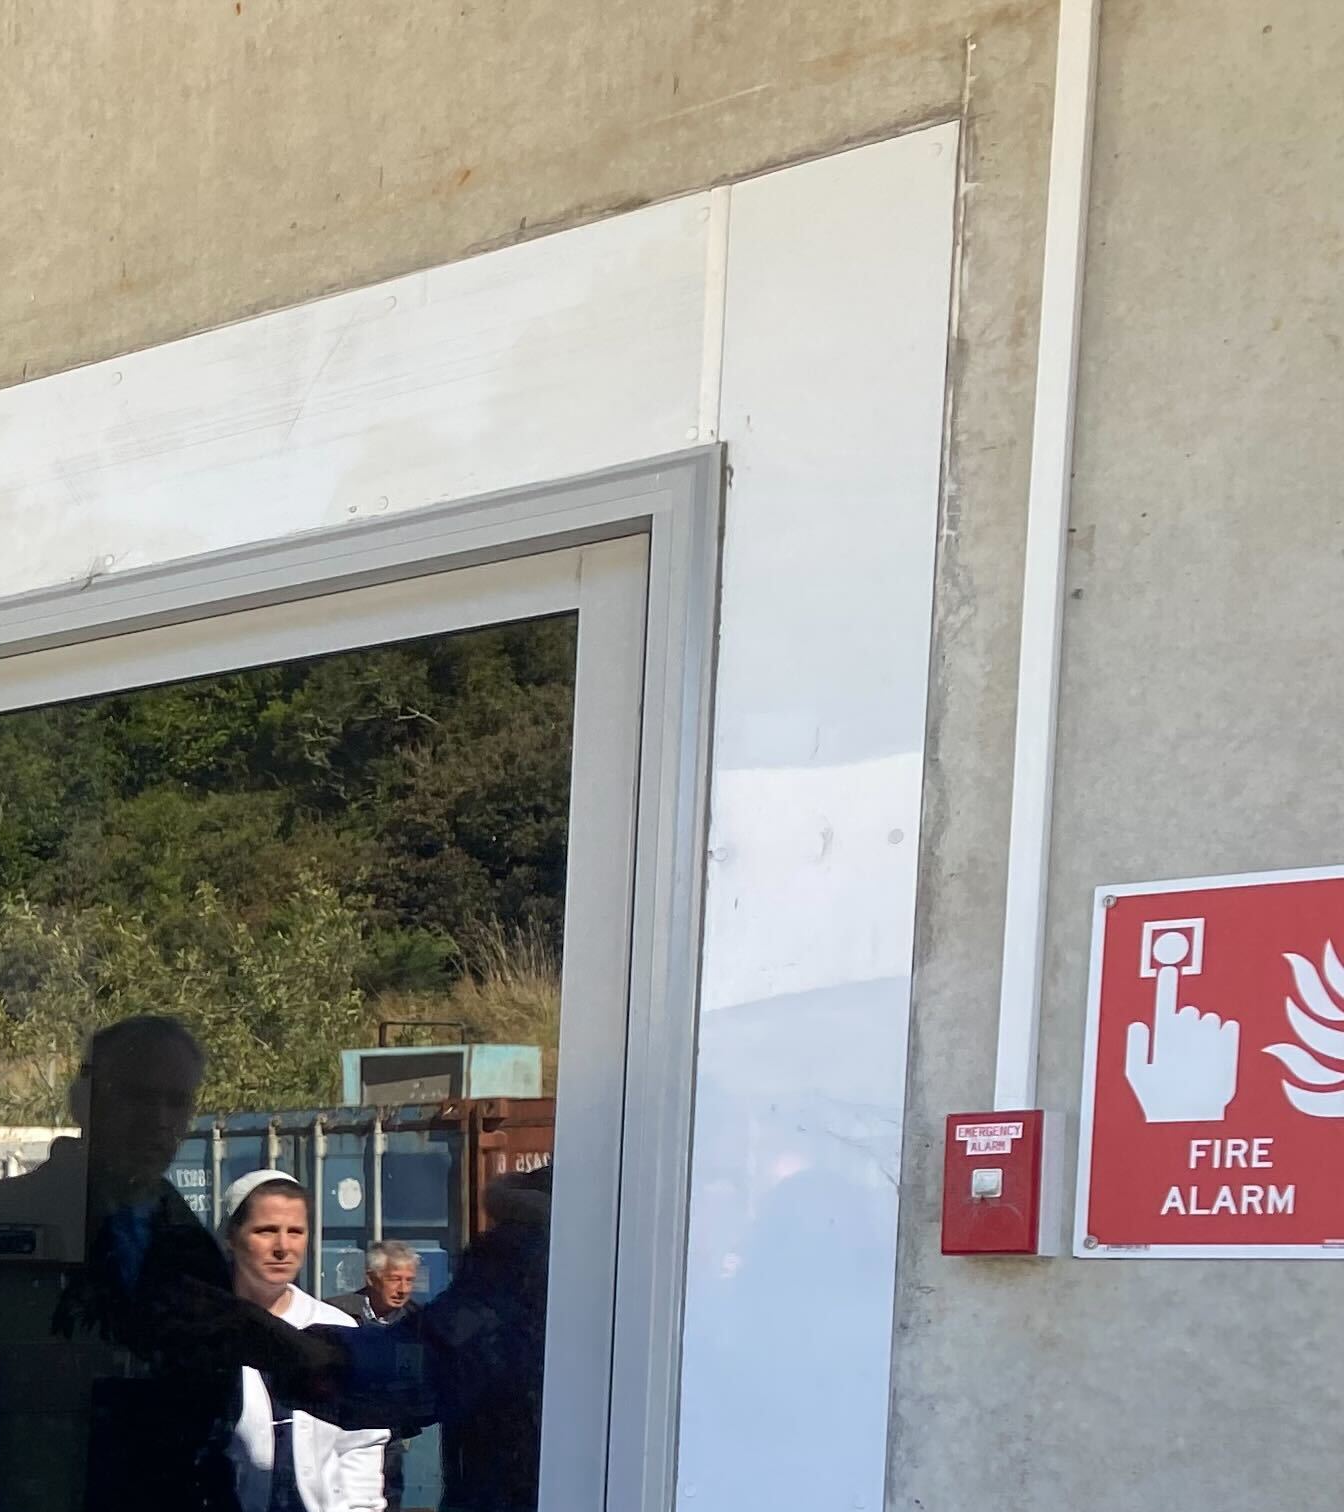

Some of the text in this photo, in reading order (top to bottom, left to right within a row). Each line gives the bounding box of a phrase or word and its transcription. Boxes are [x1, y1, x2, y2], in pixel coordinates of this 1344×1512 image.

[958, 1125, 1020, 1138] EMERGENCY
[970, 1141, 1006, 1152] ALARM
[1189, 1137, 1274, 1169] FIRE
[1160, 1184, 1296, 1215] ALARM
